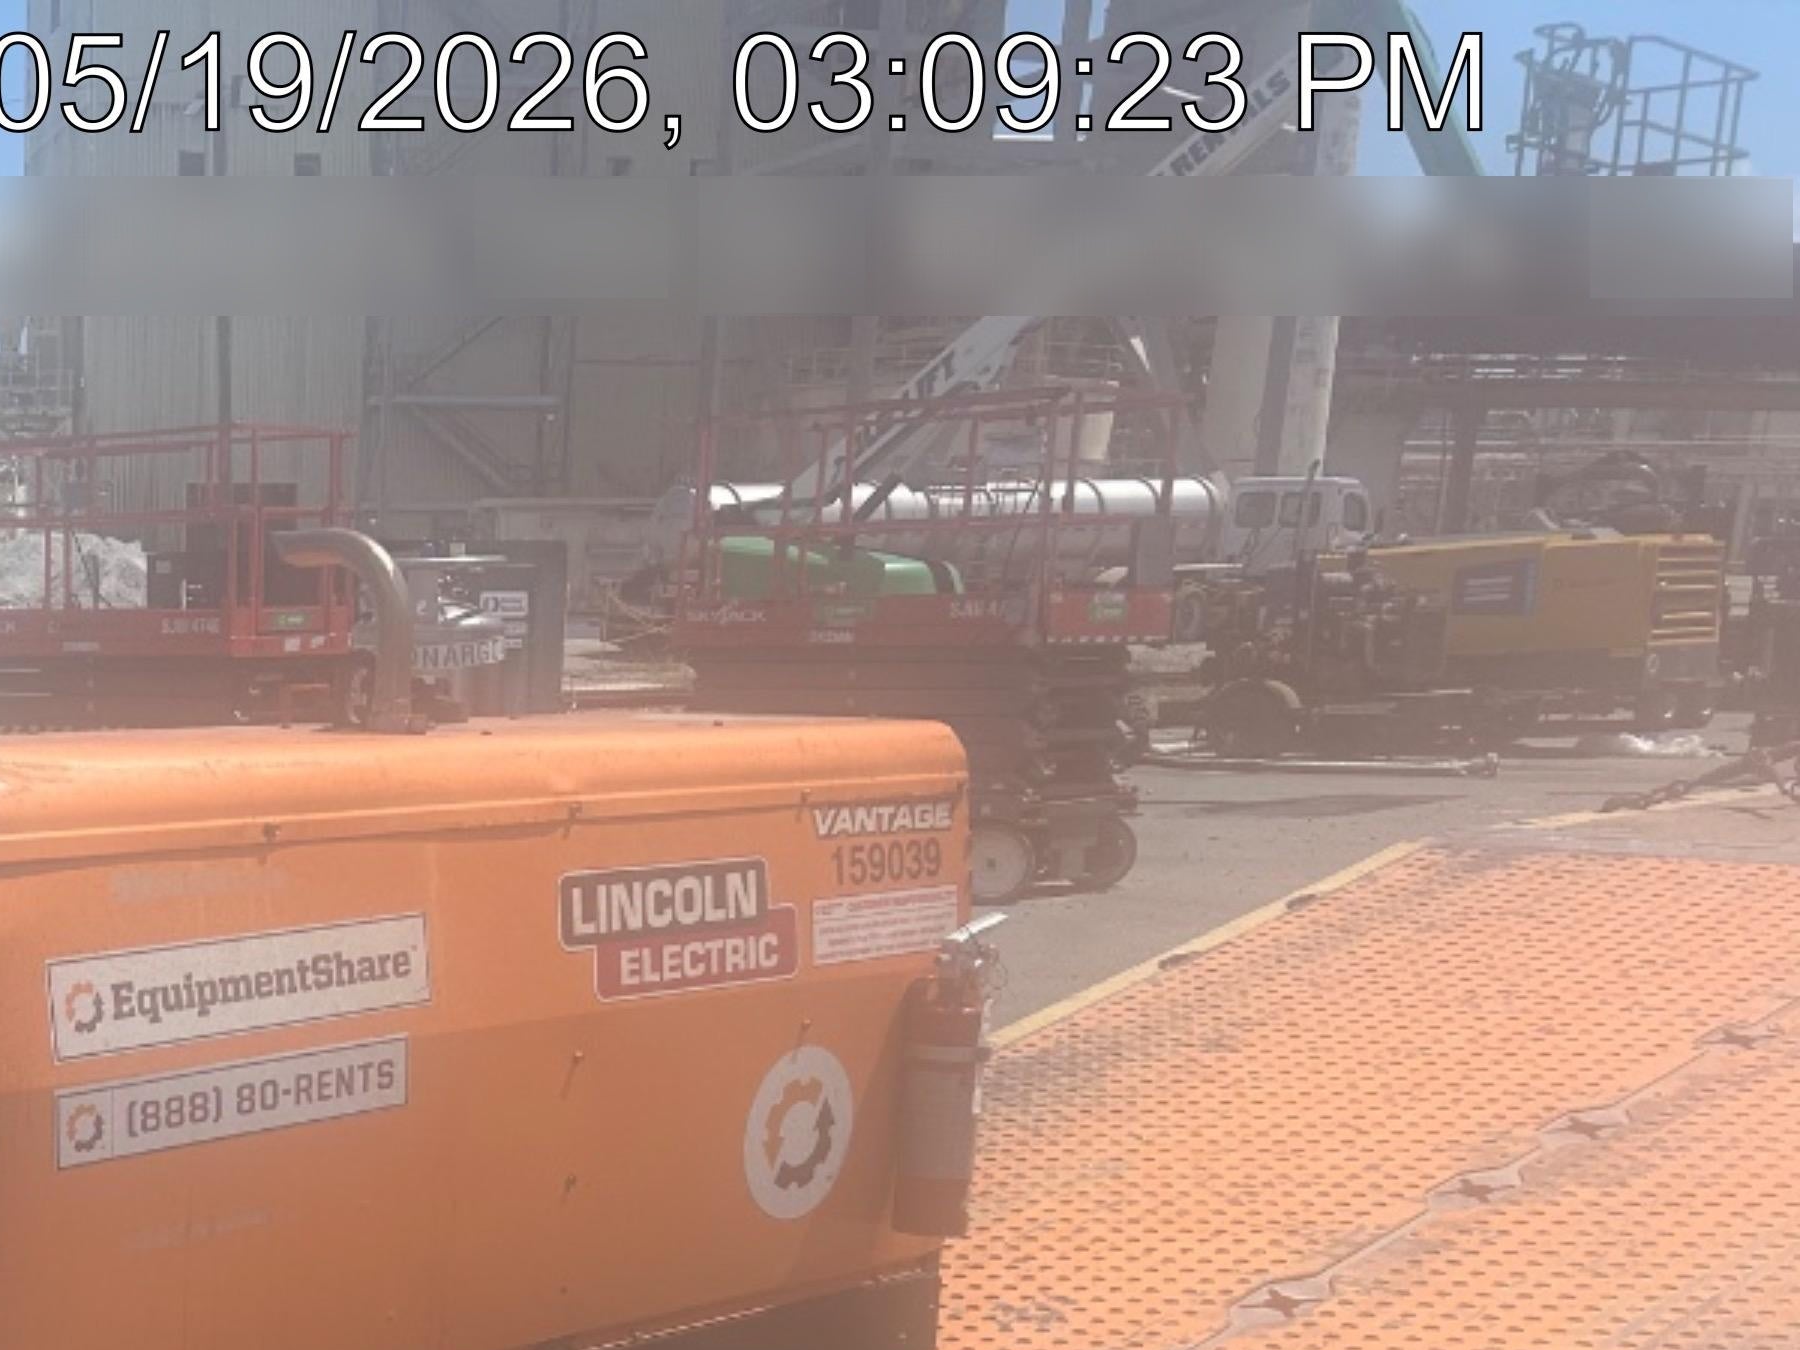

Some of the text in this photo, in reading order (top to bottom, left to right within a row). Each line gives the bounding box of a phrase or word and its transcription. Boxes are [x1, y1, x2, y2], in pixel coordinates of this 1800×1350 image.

[813, 803, 953, 836] VANTAGE
[831, 837, 942, 886] 159039
[571, 869, 759, 937] LINCOLN
[110, 948, 414, 1024] EquipmentShare
[619, 932, 780, 987] ELECTRIC
[126, 1058, 395, 1138] (888) 80-RENTS
